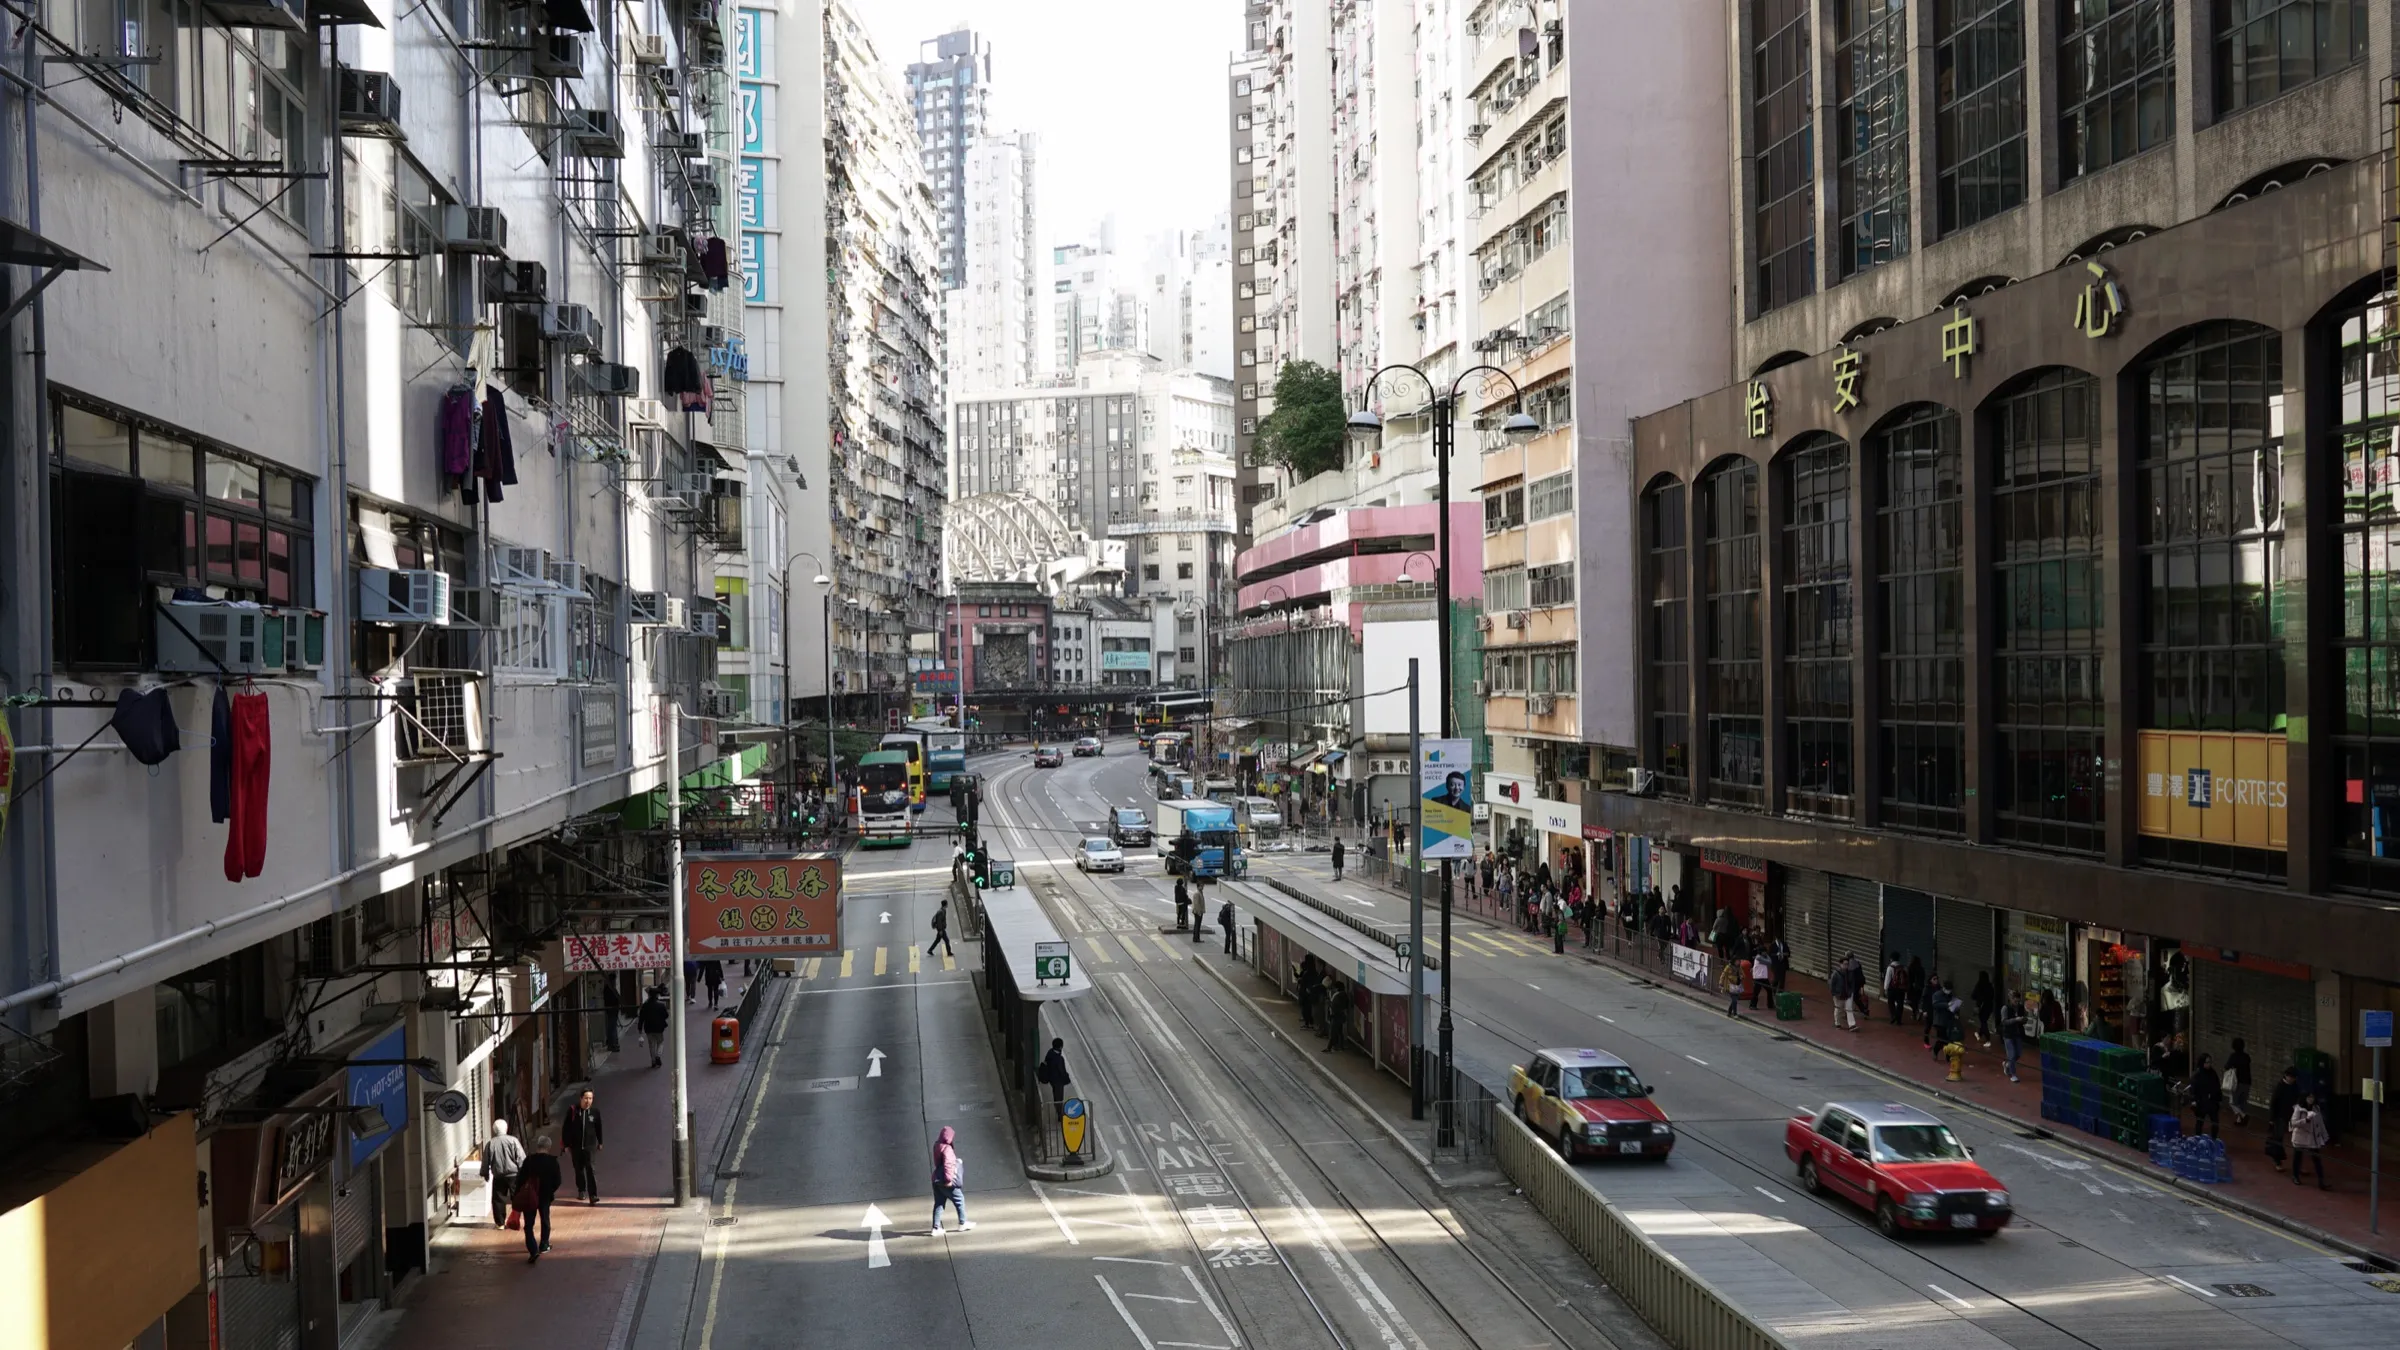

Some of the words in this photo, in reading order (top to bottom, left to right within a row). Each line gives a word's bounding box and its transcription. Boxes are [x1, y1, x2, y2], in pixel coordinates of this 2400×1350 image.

[565, 933, 671, 957] 百福老人院
[371, 1064, 404, 1100] HOT-STAR
[1110, 1120, 1227, 1146] TRAM
[1116, 1143, 1245, 1171] LANE
